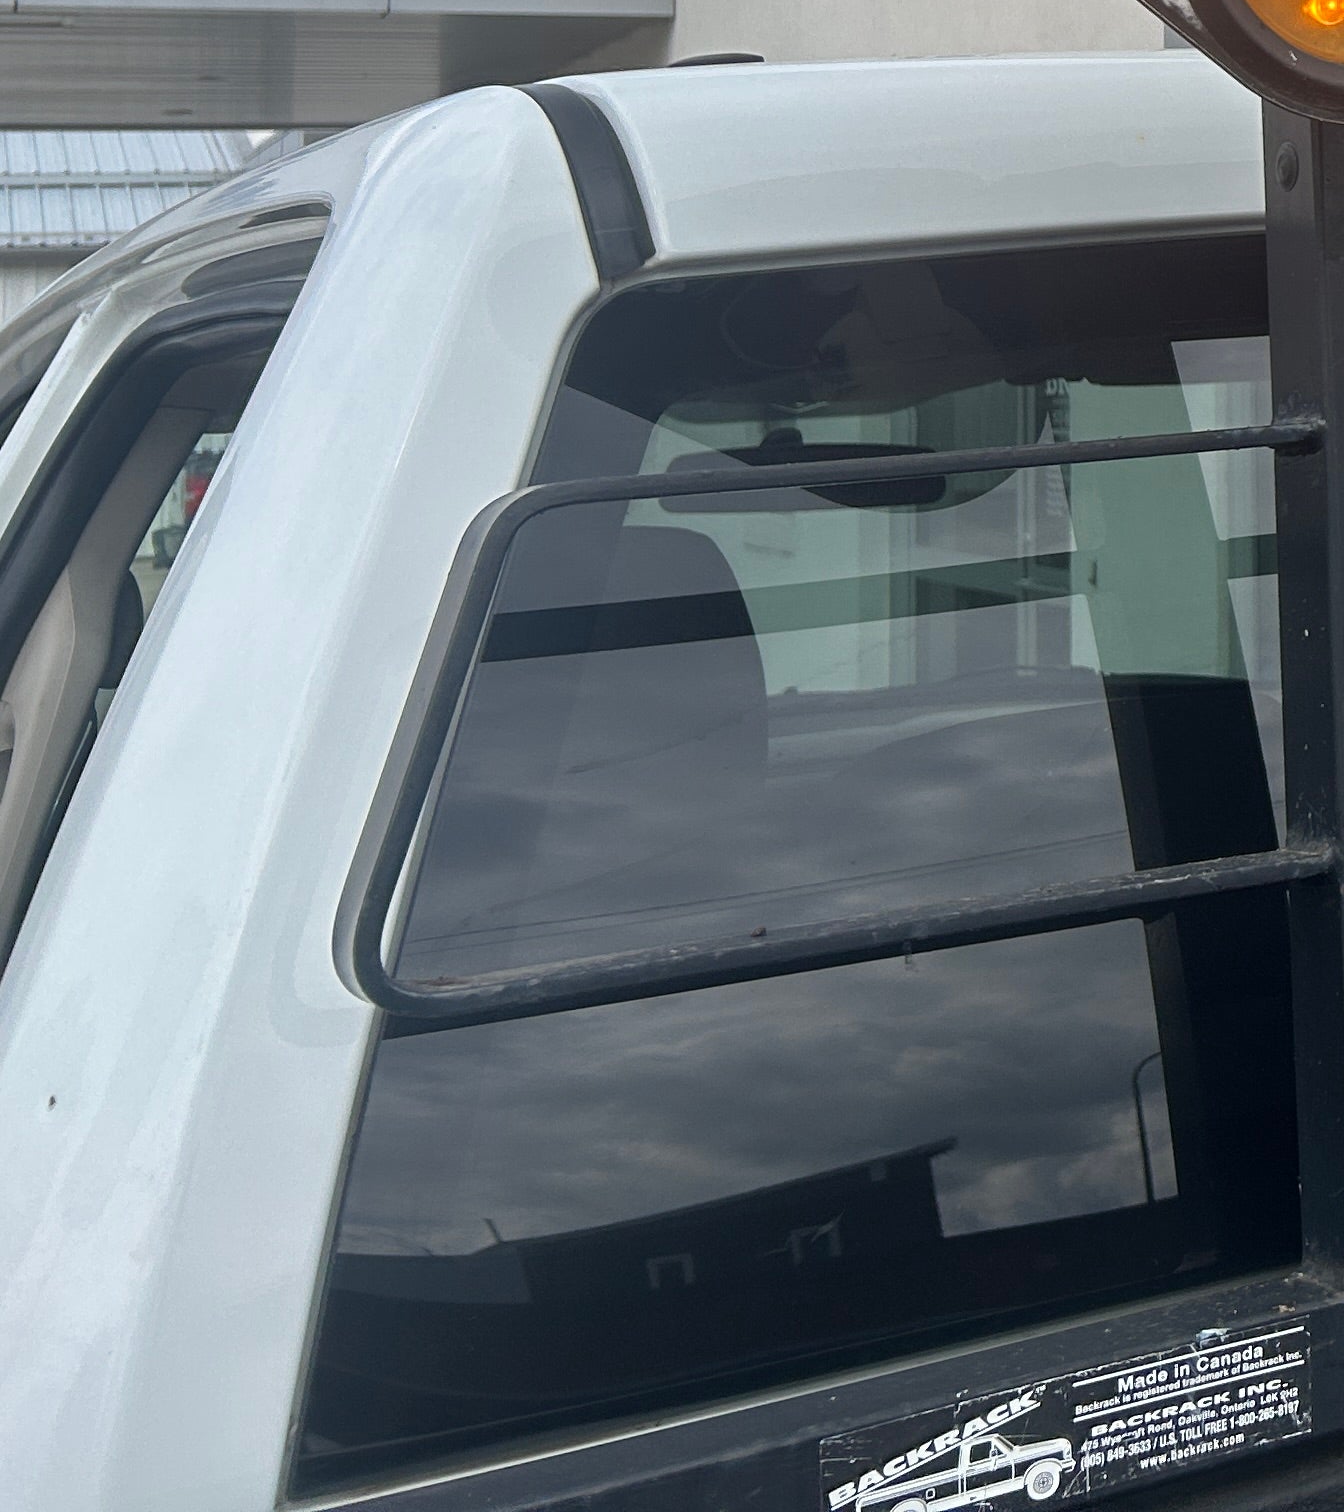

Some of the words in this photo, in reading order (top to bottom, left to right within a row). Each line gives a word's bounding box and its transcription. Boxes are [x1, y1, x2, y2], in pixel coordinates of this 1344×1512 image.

[1075, 1398, 1121, 1415] Backrack
[1133, 1381, 1181, 1404] registered
[1182, 1370, 1230, 1387] trademark
[1231, 1364, 1242, 1374] of
[1242, 1356, 1284, 1373] Backrack
[1117, 1370, 1168, 1393] Made
[1174, 1363, 1190, 1378] in
[1196, 1345, 1264, 1370] Canada
[1091, 1391, 1231, 1437] BACKRACK
[1238, 1378, 1289, 1399] INC.
[1220, 1398, 1256, 1415] Ontario
[1139, 1433, 1245, 1469] www.backrack.com
[1179, 1426, 1203, 1444] TOLL
[1204, 1417, 1228, 1436] FREE
